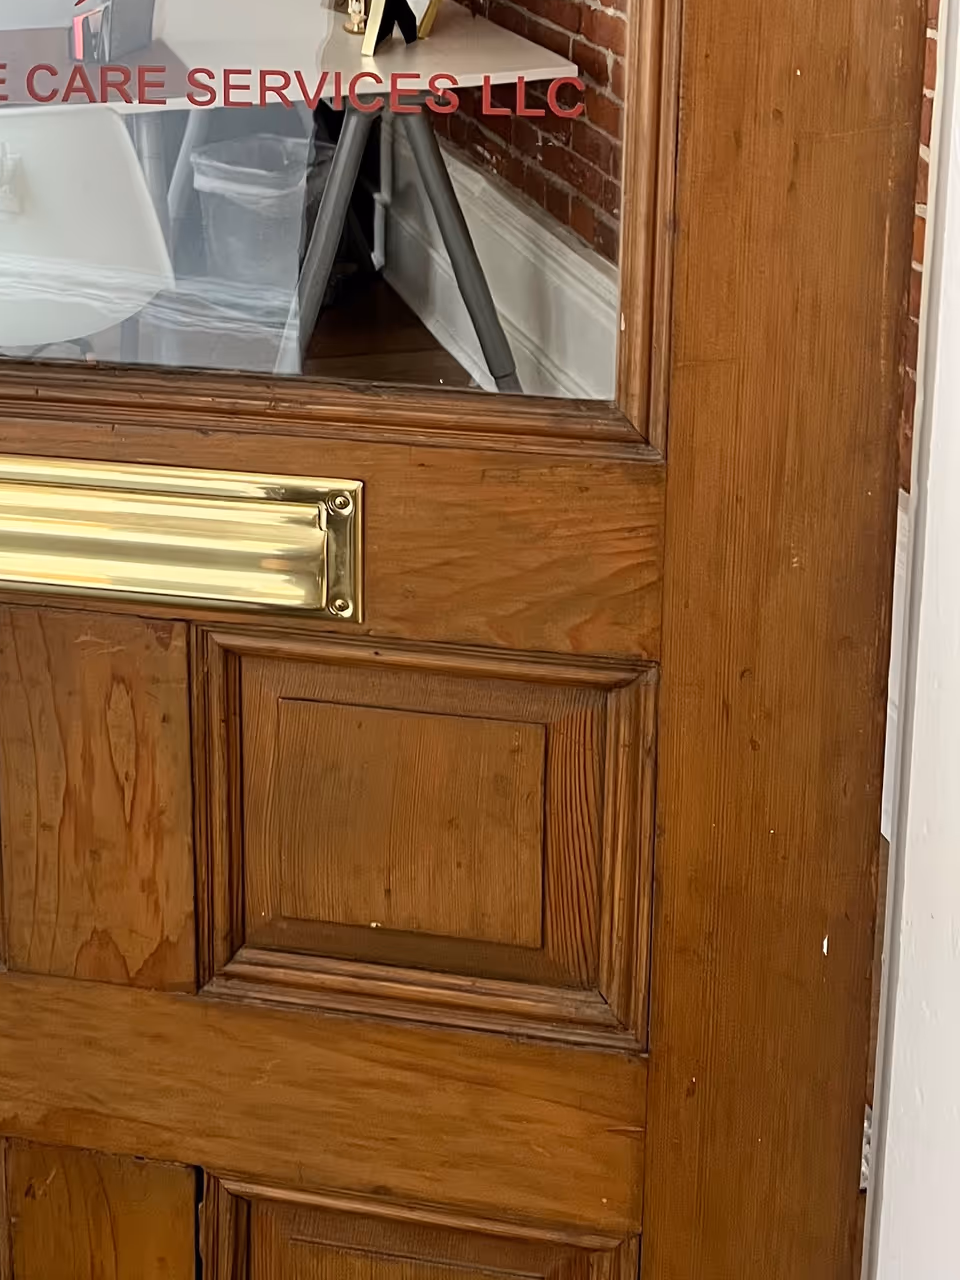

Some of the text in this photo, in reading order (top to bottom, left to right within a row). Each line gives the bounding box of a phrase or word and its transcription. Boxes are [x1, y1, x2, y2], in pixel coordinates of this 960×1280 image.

[25, 64, 168, 106] CARE
[186, 67, 460, 115] SERVICES
[482, 74, 586, 118] LLC
